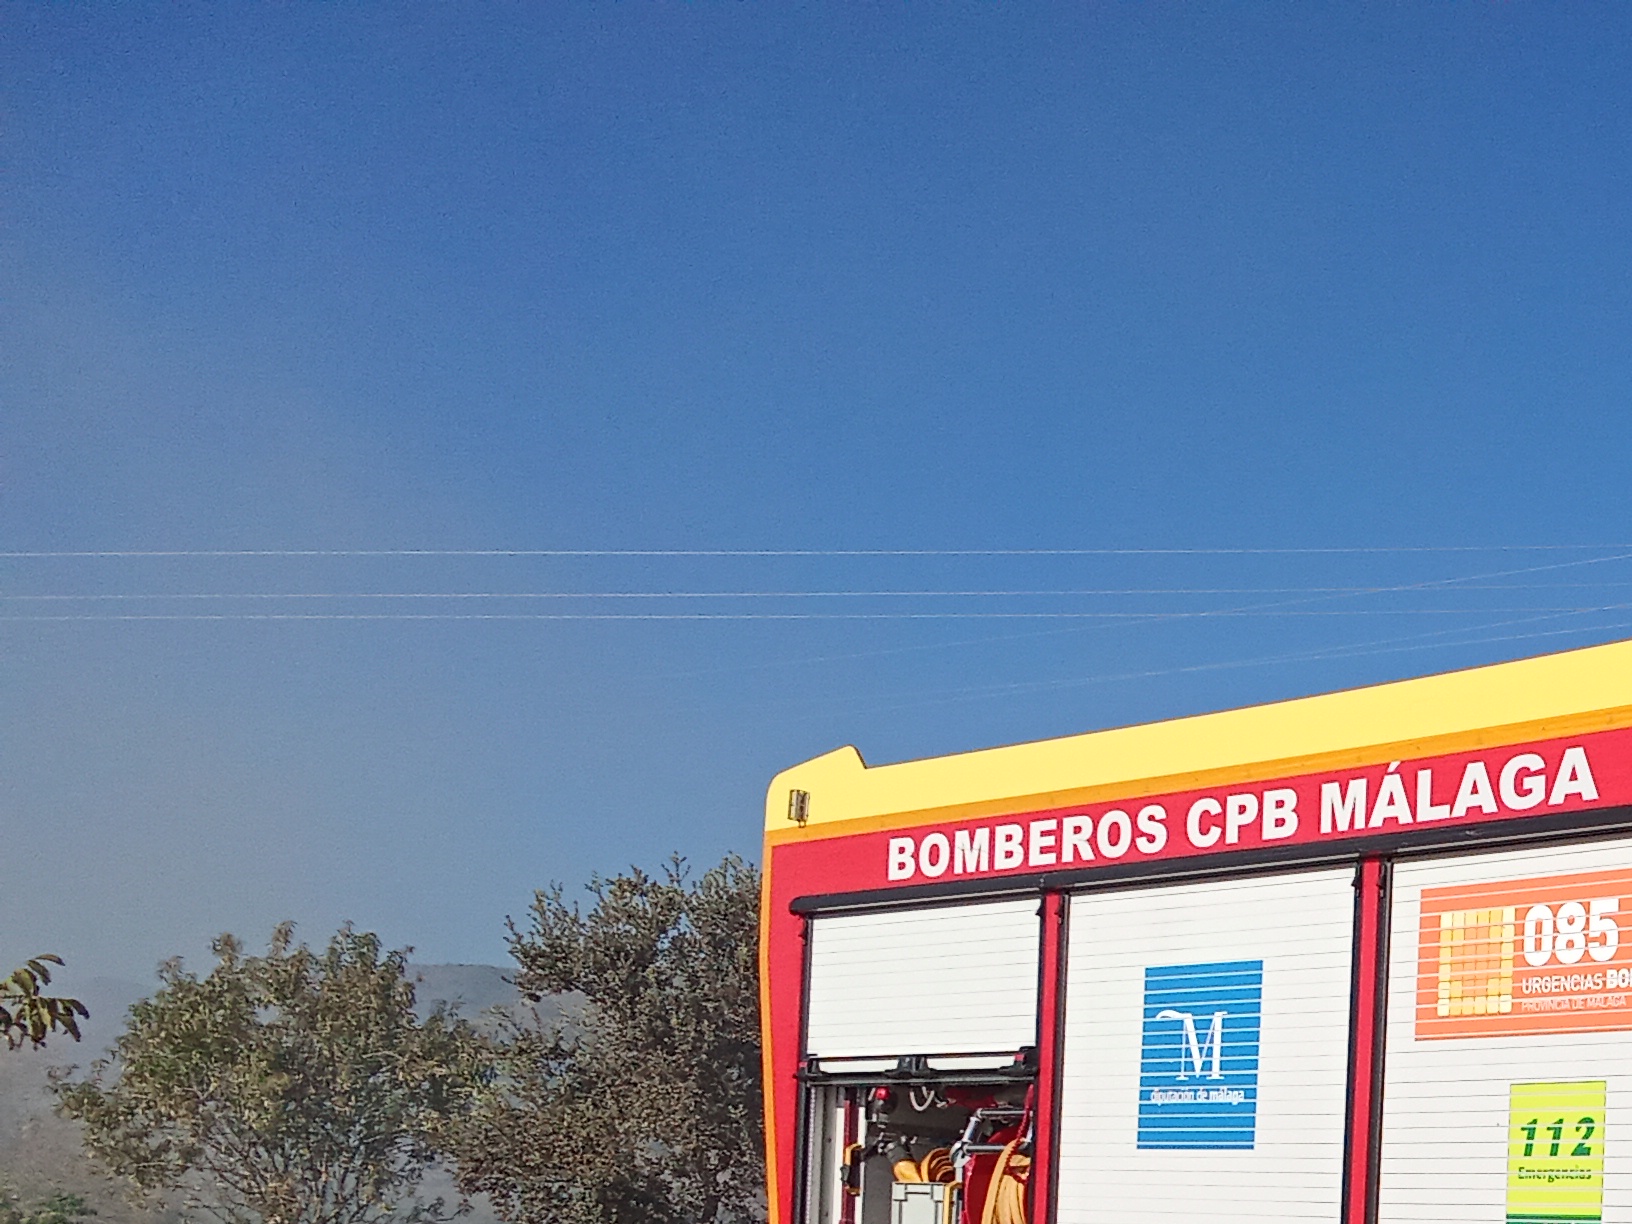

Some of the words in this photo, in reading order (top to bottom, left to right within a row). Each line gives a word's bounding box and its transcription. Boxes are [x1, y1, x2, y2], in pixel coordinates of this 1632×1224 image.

[887, 804, 1168, 881] BOMBEROS
[1186, 788, 1299, 849] CPB
[1321, 746, 1600, 834] MÁLAGA
[1522, 898, 1620, 967] 085
[1521, 972, 1603, 995] URGENCIAS
[1521, 998, 1571, 1011] PROVINCIA
[1573, 998, 1586, 1009] DE
[1520, 1116, 1596, 1157] 112
